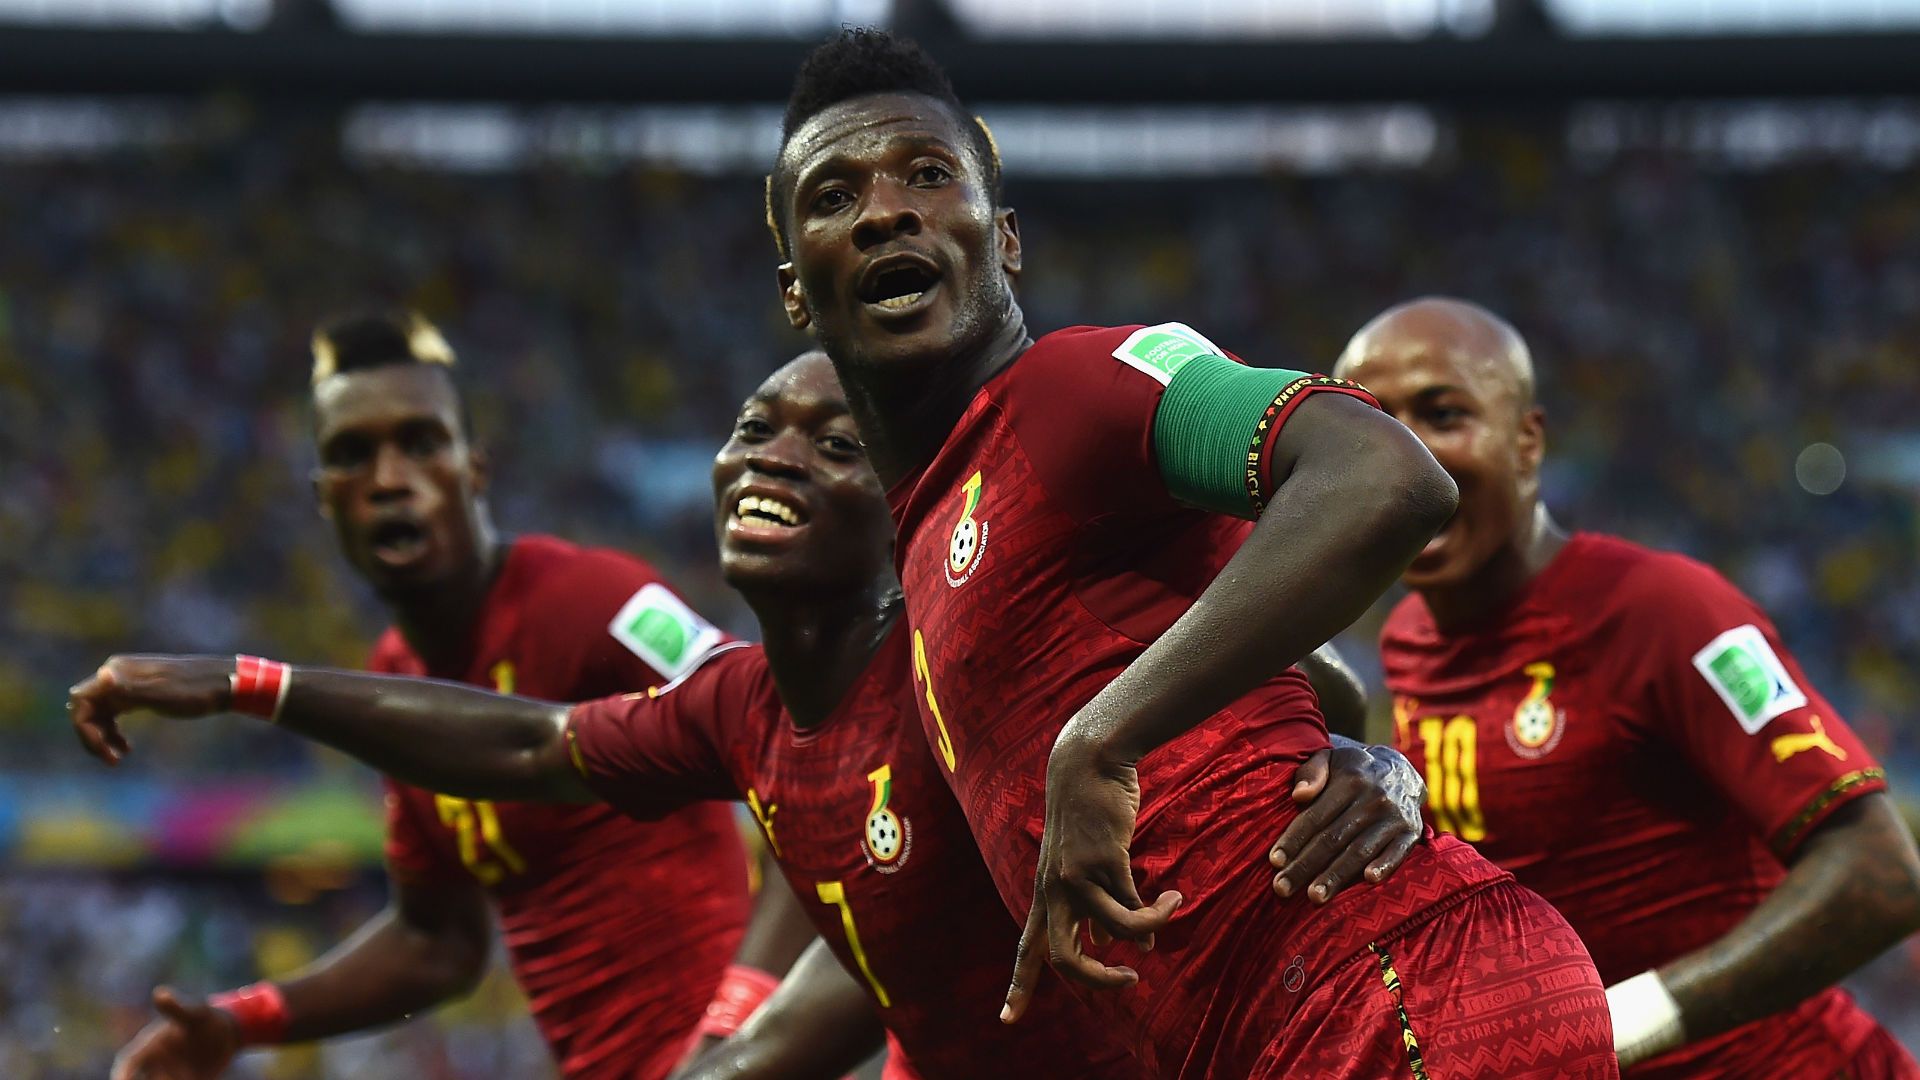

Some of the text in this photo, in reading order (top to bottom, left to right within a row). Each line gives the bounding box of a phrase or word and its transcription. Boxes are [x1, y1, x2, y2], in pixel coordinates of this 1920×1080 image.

[1152, 350, 1168, 363] FOR
[1274, 379, 1312, 406] GHANA
[1247, 452, 1261, 498] BLACK
[968, 520, 989, 576] ASSOCIATION
[914, 629, 956, 773] 3
[1418, 715, 1487, 842] 10
[815, 880, 891, 1008] 7
[1461, 1020, 1499, 1042] STARS
